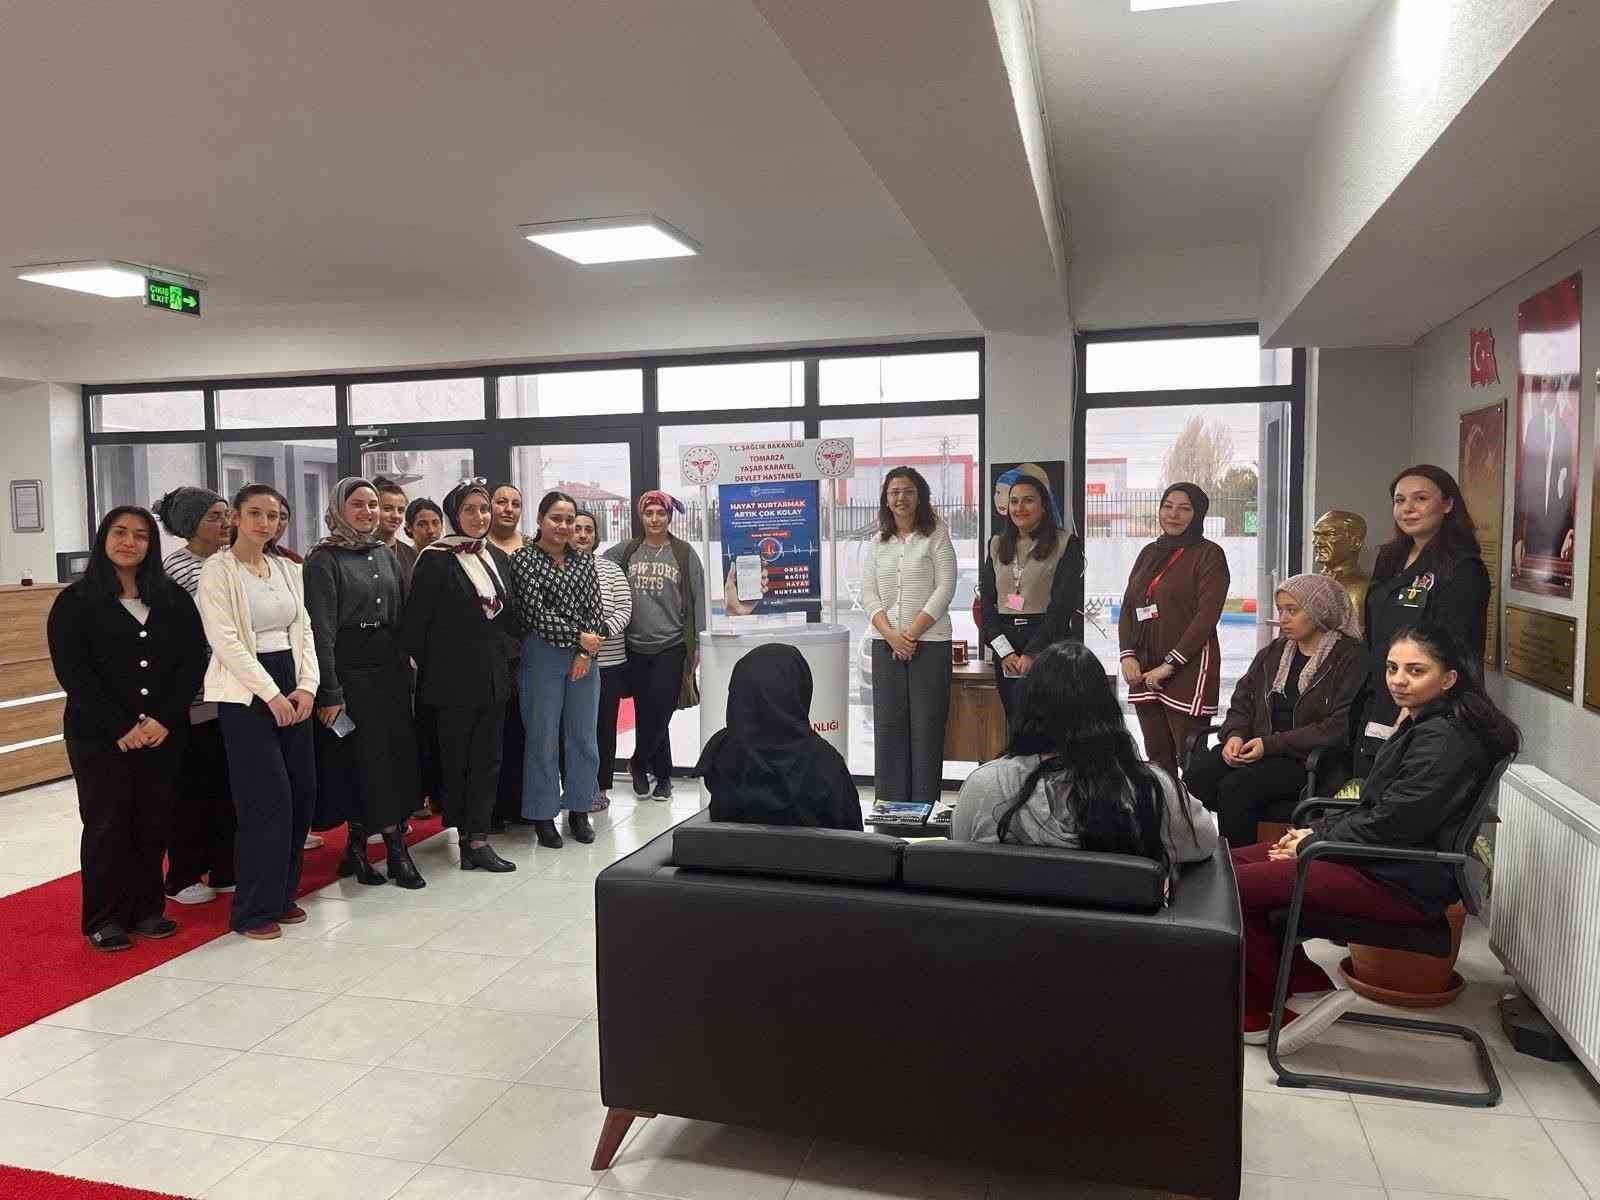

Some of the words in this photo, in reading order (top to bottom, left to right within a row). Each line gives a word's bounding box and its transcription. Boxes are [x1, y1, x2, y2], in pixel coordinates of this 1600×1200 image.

[151, 294, 169, 304] EXIT
[742, 443, 765, 451] SAĞLIK
[767, 440, 804, 449] BAKANLIĞI
[750, 454, 785, 462] TOMARZA
[740, 465, 763, 473] YAŞAR
[764, 463, 795, 471] KARAYEL
[735, 474, 761, 482] DEVLET
[730, 502, 755, 510] HAYAT
[757, 500, 806, 509] KURTARMAK
[734, 510, 757, 518] ARTIK
[759, 510, 775, 518] ÇOK
[814, 720, 839, 732] NLIĞI
